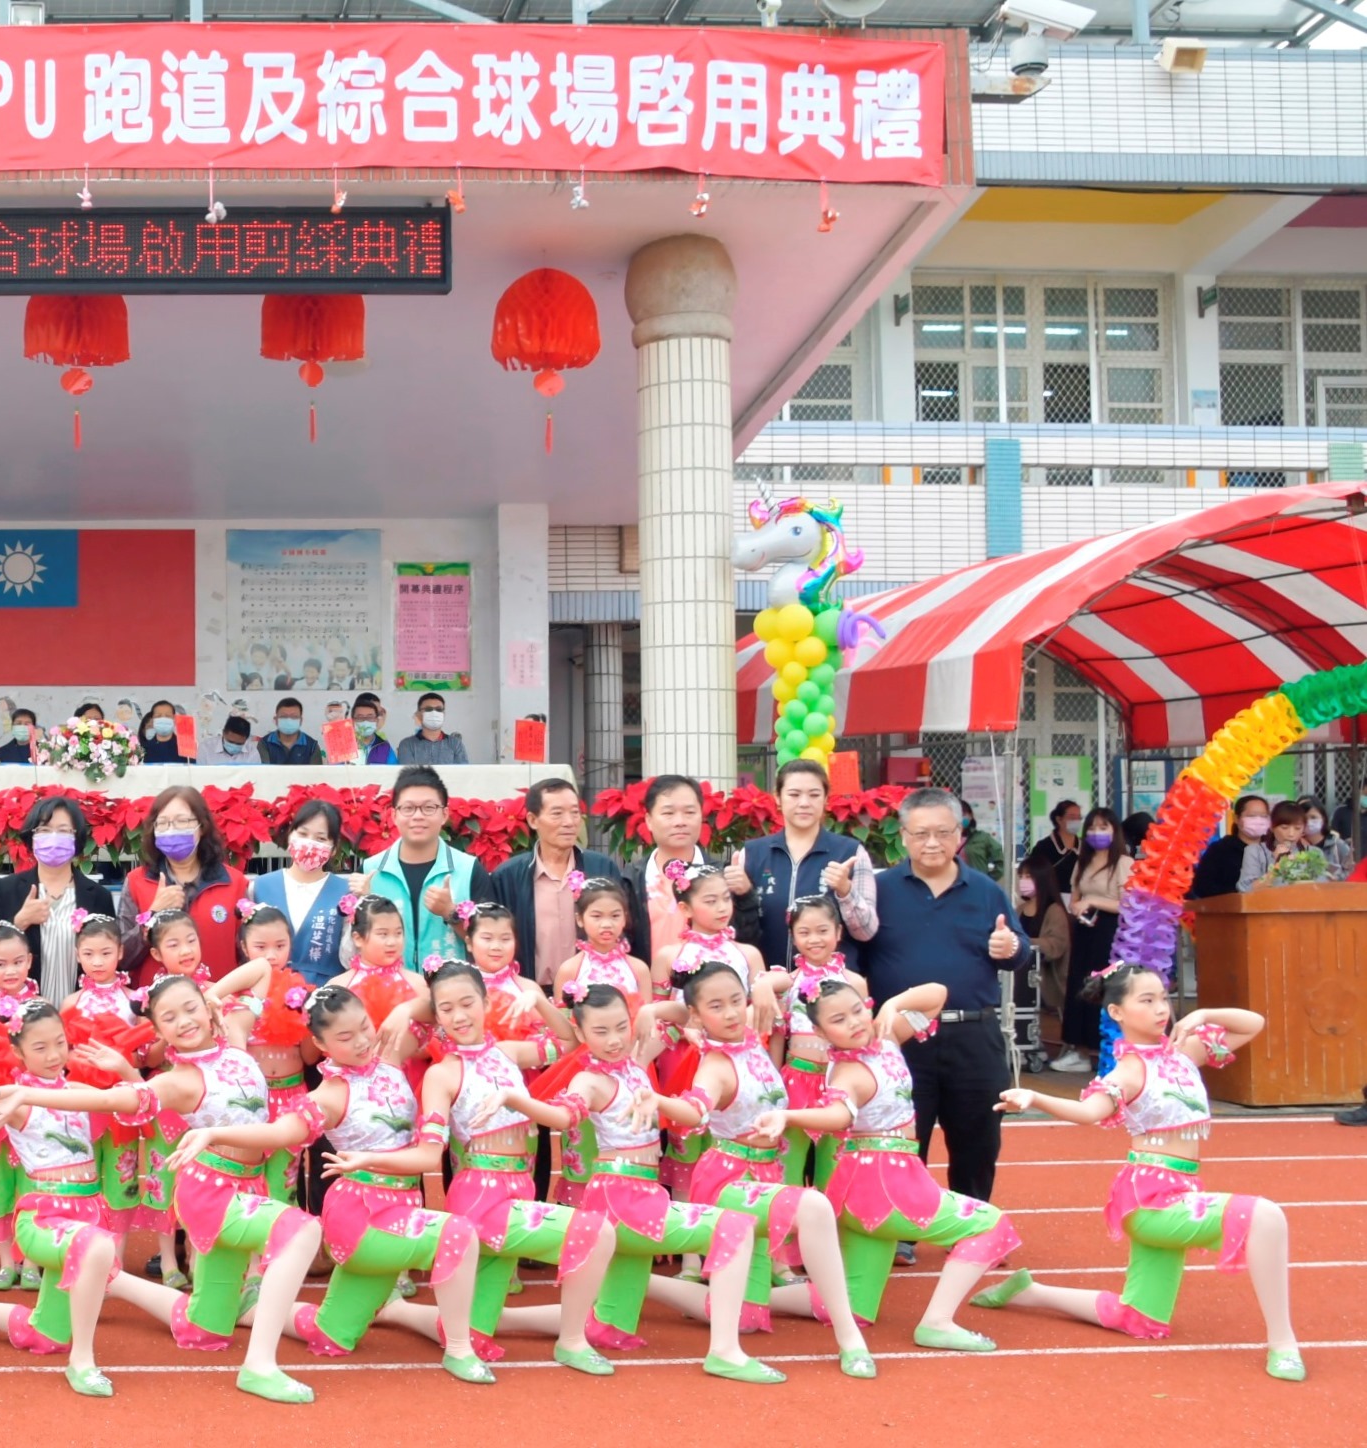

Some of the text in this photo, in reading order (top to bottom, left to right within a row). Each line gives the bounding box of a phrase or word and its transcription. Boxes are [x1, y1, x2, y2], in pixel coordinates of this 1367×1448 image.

[399, 583, 464, 595] 開幕典禮程序
